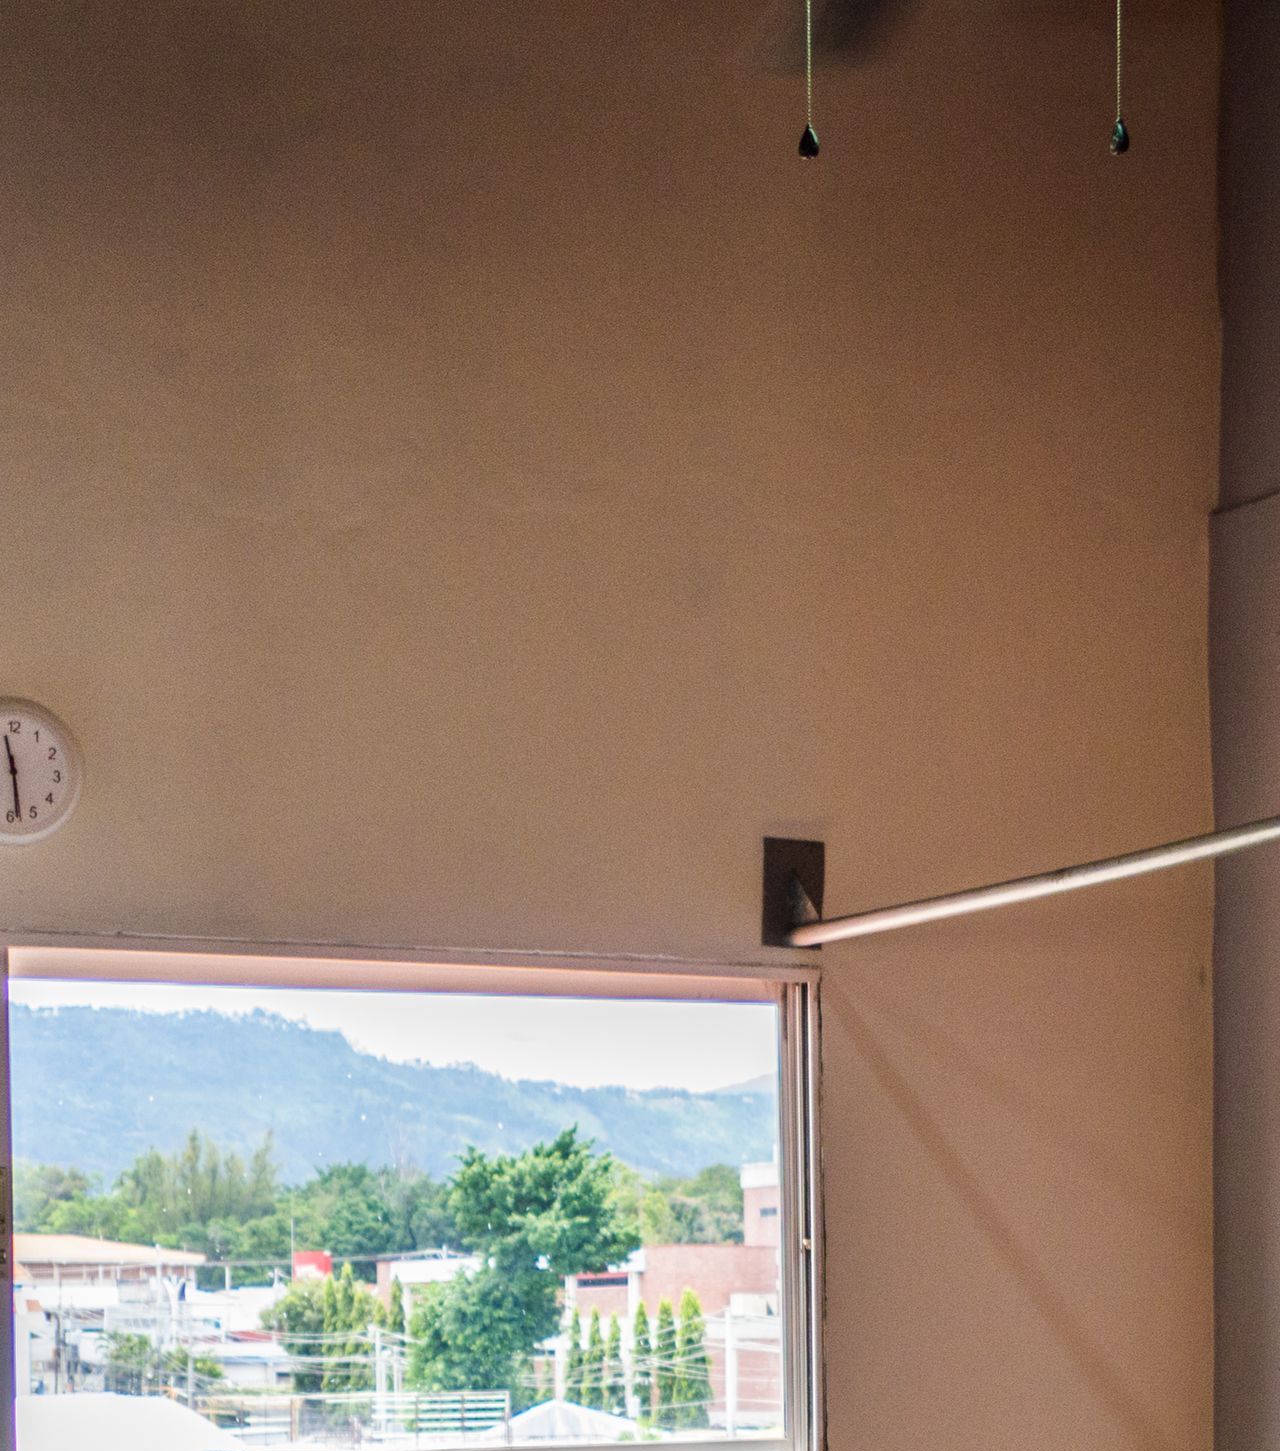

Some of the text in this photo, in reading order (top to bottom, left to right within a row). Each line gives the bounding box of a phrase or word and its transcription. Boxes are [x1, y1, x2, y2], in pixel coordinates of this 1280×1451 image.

[7, 721, 21, 734] 12
[33, 730, 39, 742] 1
[48, 747, 57, 760] 2
[53, 770, 61, 783] 3
[45, 792, 54, 805] 4
[6, 811, 15, 823] 6
[29, 806, 38, 819] 5
